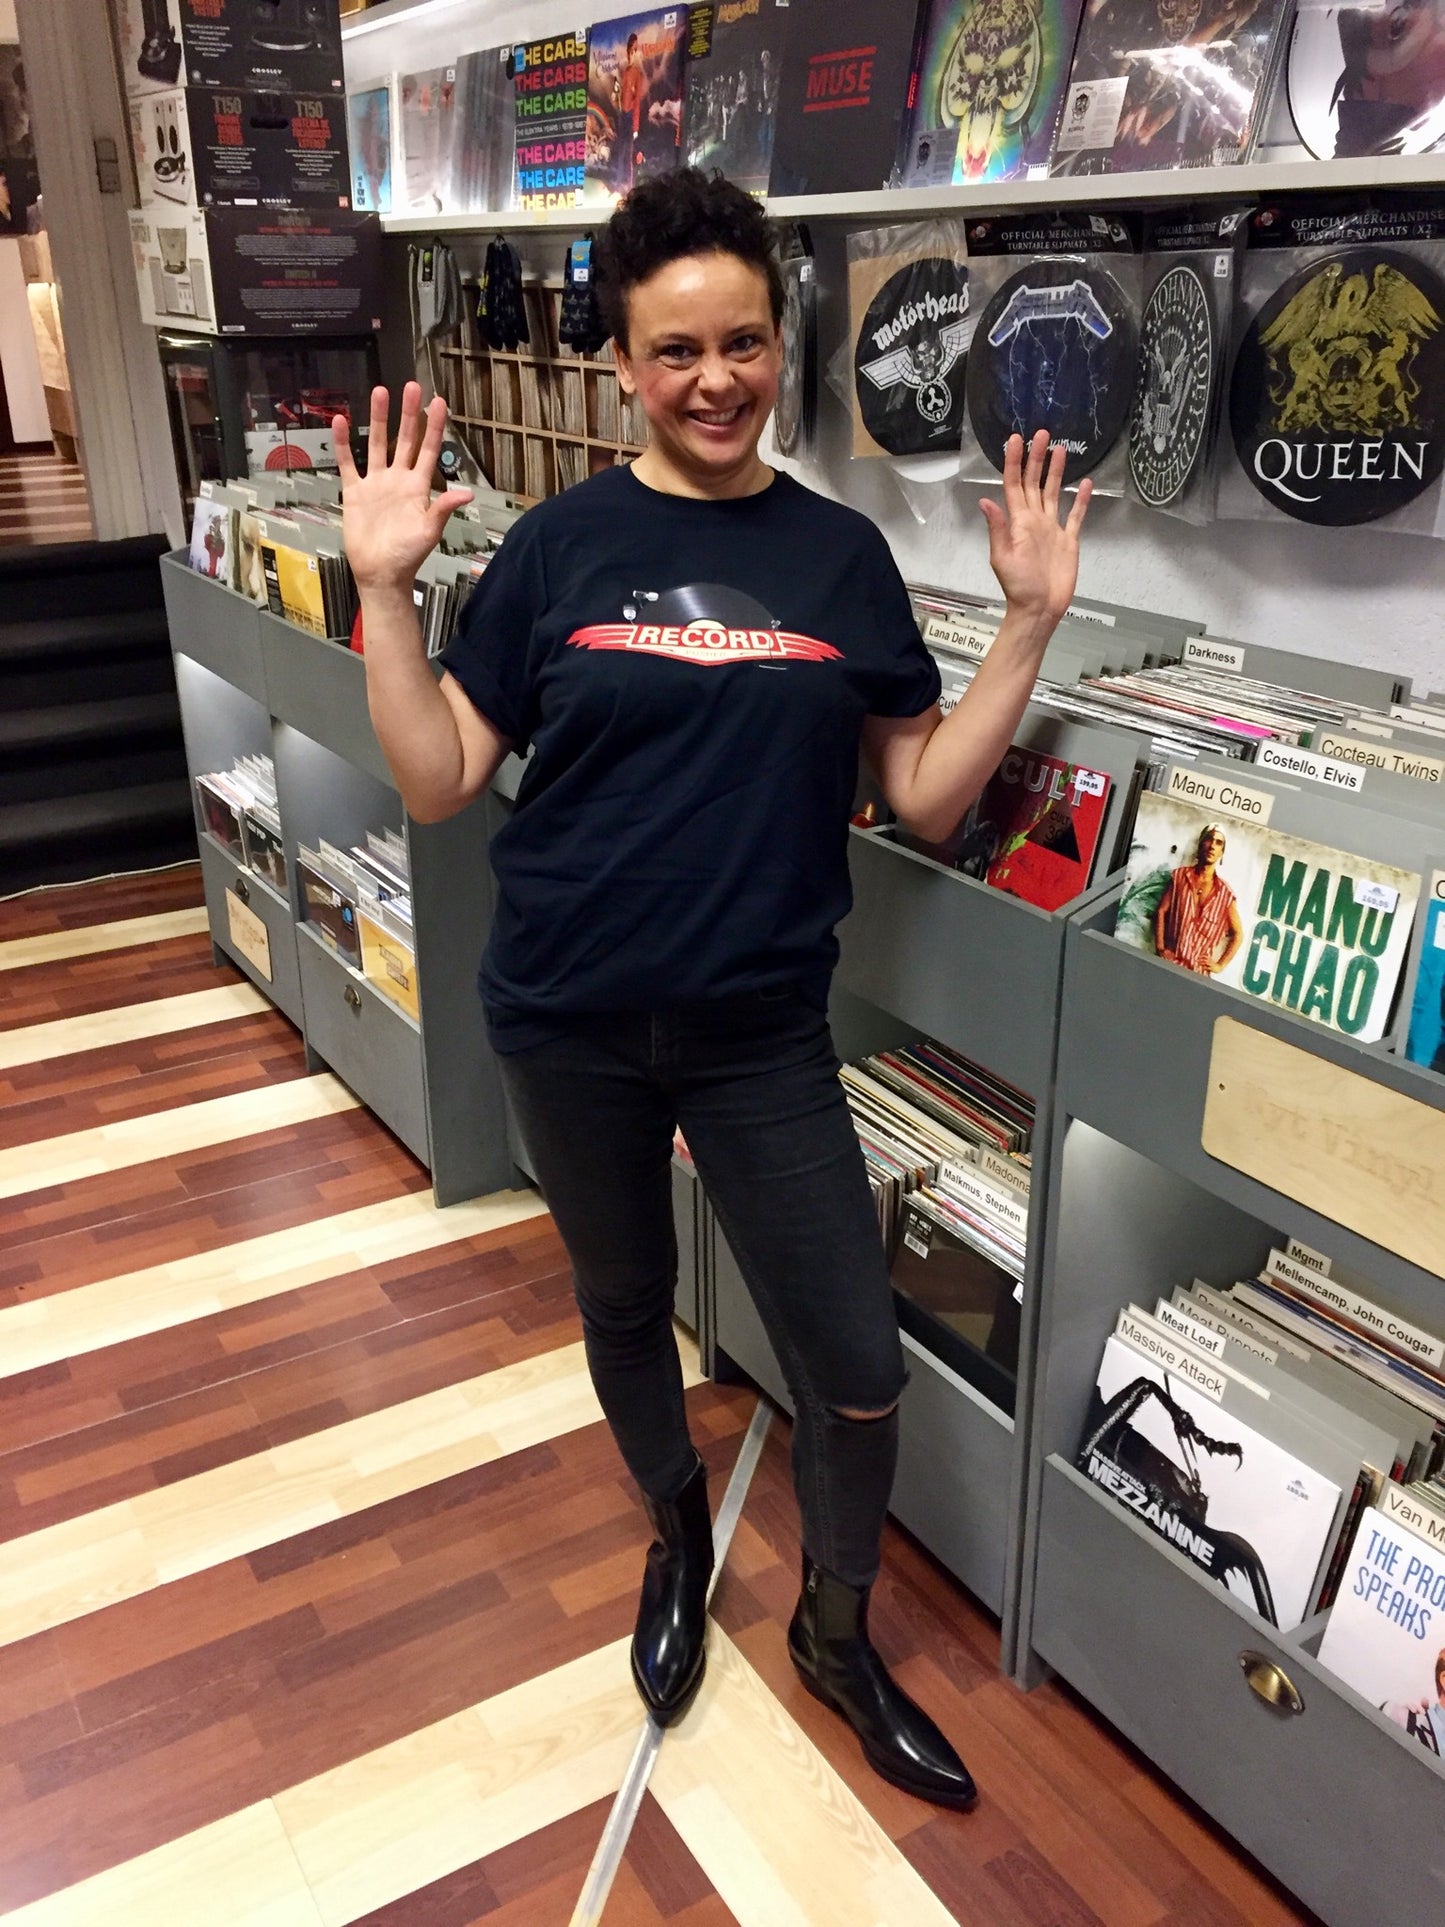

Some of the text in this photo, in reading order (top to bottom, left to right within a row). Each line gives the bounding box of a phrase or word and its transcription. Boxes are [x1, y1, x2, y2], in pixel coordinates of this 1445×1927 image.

[251, 67, 283, 75] CROSLEY
[523, 46, 542, 66] HE
[543, 38, 587, 64] CARS
[515, 71, 542, 92] THE
[543, 62, 587, 88] CARS
[806, 61, 874, 98] MUSE
[516, 88, 587, 117] THE CARS
[517, 140, 586, 165] THE CARS
[518, 166, 586, 189] THE CARS
[519, 191, 575, 211] THE CAR
[1291, 209, 1445, 230] OFFICIAL MERCHANDISE
[1001, 230, 1045, 240] OFFICIAL
[1007, 241, 1050, 250] TURNTABLE
[1297, 229, 1352, 242] TURNTABLE
[1359, 226, 1408, 240] SLIPMATS
[1153, 273, 1203, 324] JOHNNY
[1192, 336, 1208, 425] JOEY
[1254, 438, 1430, 503] QUEEN
[638, 626, 775, 649] RECORD
[928, 625, 950, 641] Lana
[951, 631, 967, 646] Del
[967, 636, 986, 652] Rey
[1187, 644, 1237, 666] Darkness
[1263, 749, 1357, 788] Costello, Elvis
[1321, 739, 1440, 782] Cocteau Twins
[1000, 753, 1083, 807] CULT
[1171, 772, 1263, 815] Manu Chao
[1256, 852, 1400, 958] MANU
[1242, 918, 1380, 1035] CHAO
[985, 1156, 1031, 1194] Madonna
[943, 1168, 1021, 1223] Malkmus, Stephen
[1291, 1245, 1324, 1271] Mgmt
[1275, 1259, 1349, 1311] Mellemcamp,
[1353, 1305, 1384, 1329] John
[1387, 1322, 1435, 1357] Cougar
[1161, 1310, 1188, 1335] Meat
[1190, 1328, 1219, 1353] Loaf
[1120, 1319, 1223, 1396] Massive Attack
[1088, 1455, 1216, 1567] MEZZANINE
[1390, 1492, 1445, 1543] Van M
[1364, 1529, 1445, 1613] THE PRO
[1353, 1565, 1432, 1641] SPEAKS
